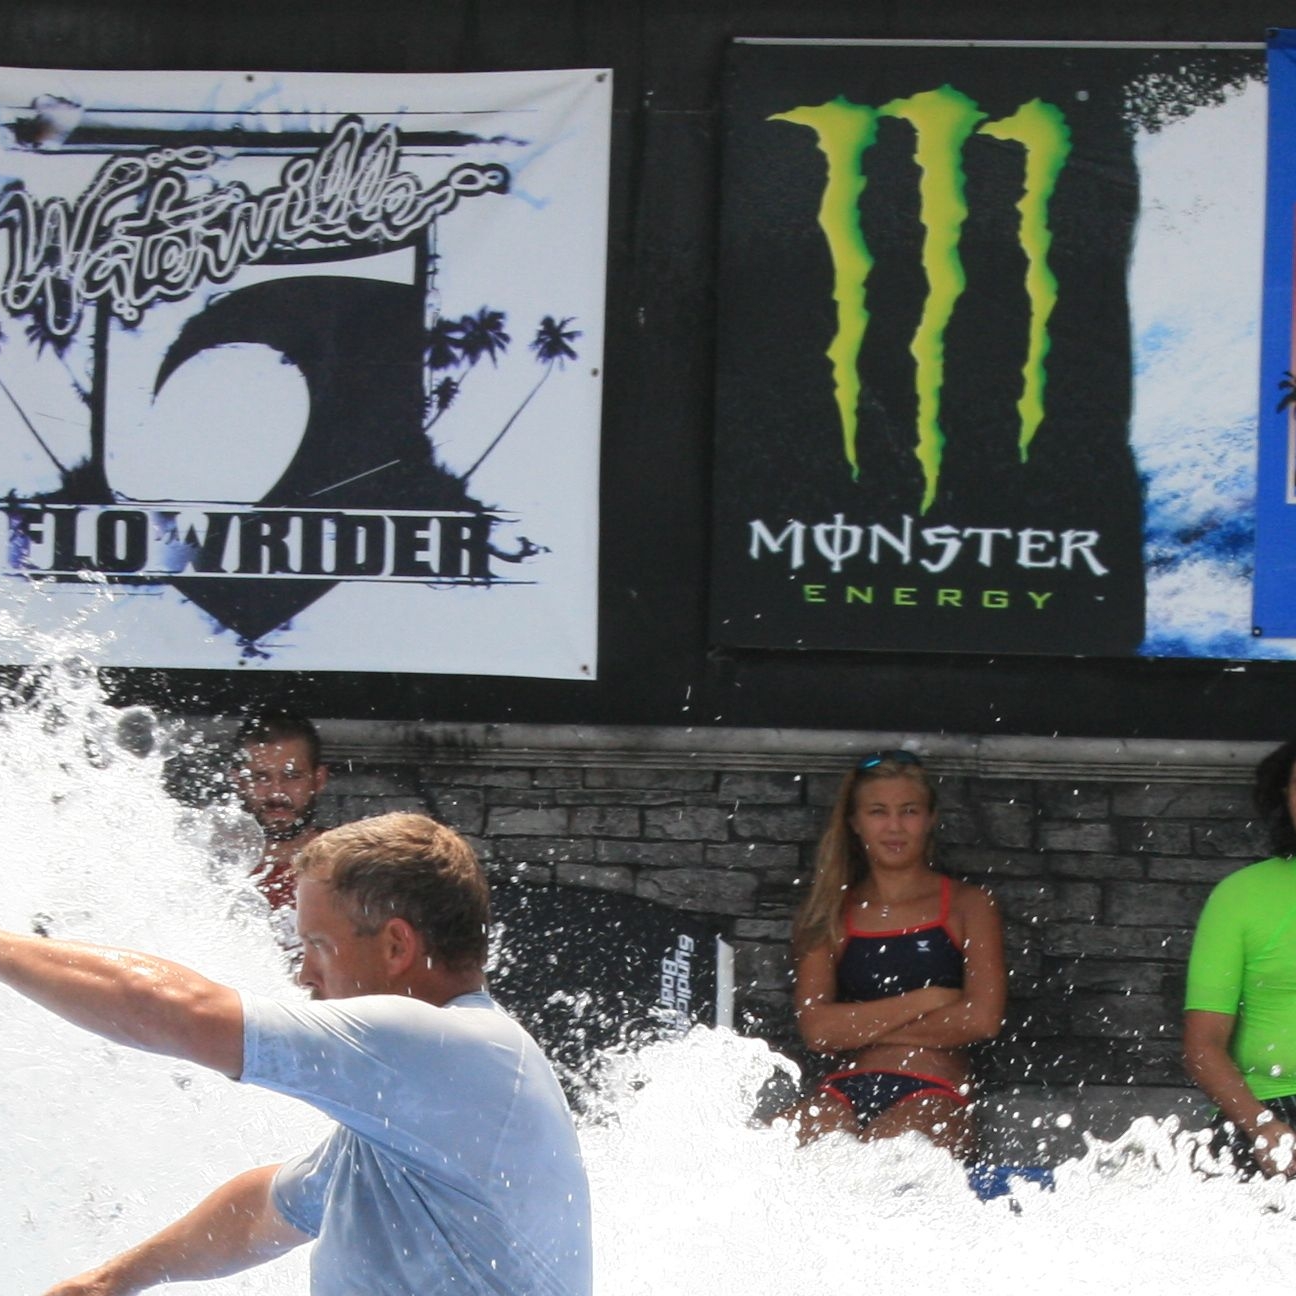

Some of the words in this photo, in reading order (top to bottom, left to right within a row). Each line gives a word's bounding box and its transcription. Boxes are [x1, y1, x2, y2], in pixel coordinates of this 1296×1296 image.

[8, 510, 494, 578] FLOWRIDER
[747, 513, 1110, 574] MONSTER
[803, 584, 1054, 610] ENERGY
